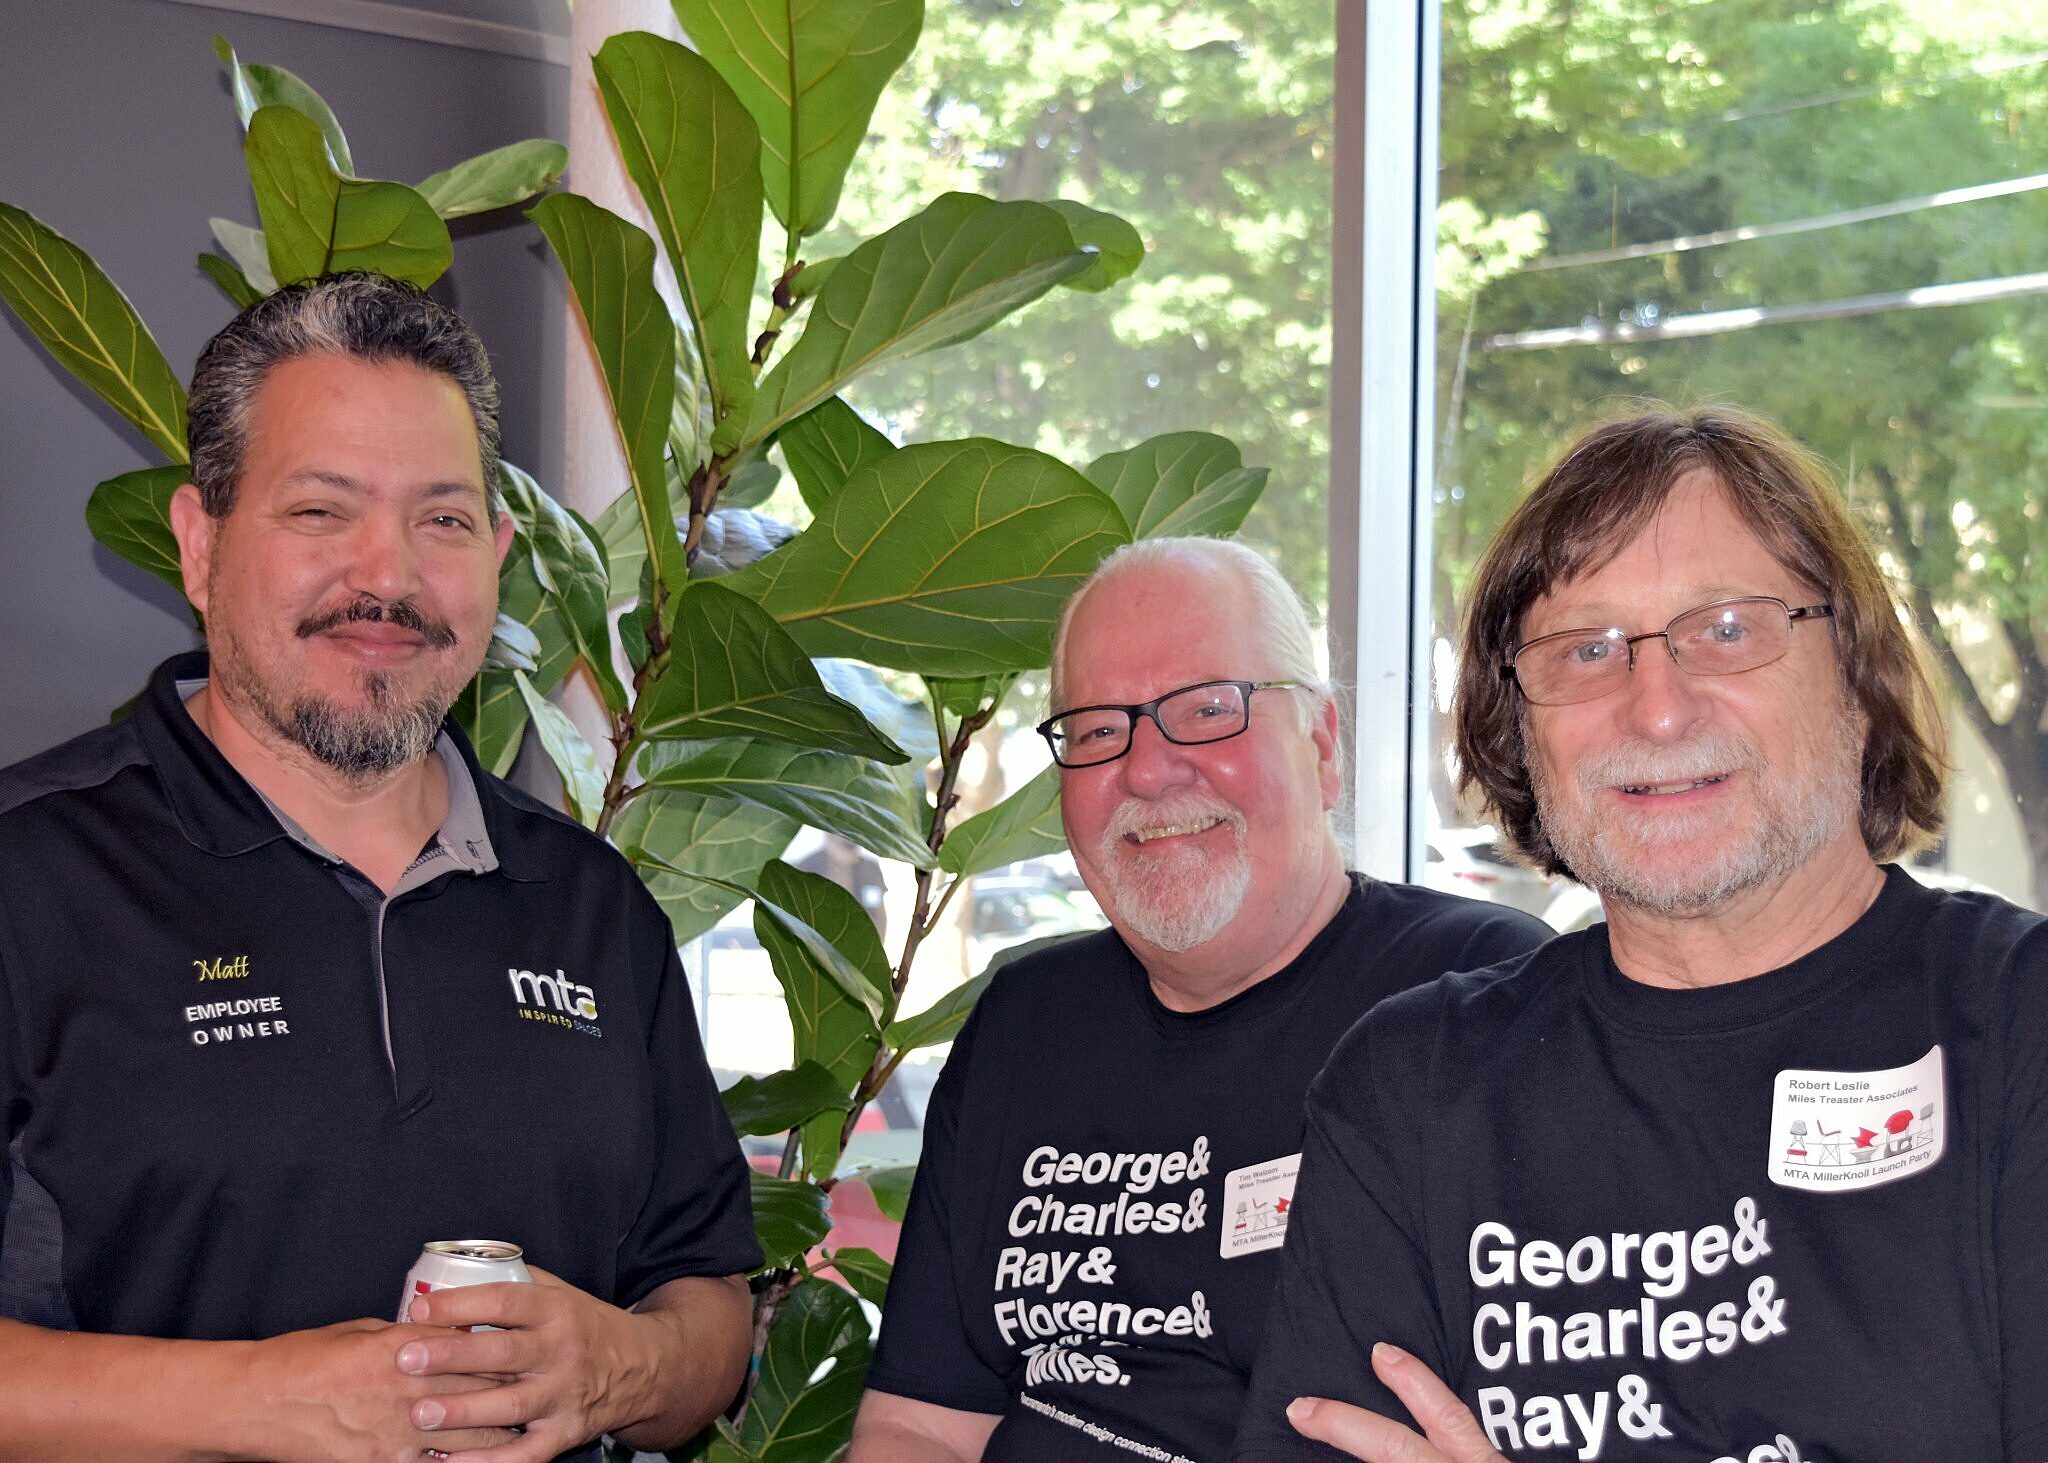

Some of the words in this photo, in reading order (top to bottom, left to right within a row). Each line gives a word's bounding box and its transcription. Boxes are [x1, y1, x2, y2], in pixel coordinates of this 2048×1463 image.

[193, 956, 250, 982] Matt
[186, 997, 282, 1022] EMPLOYEE
[508, 968, 598, 1020] mta
[193, 1020, 290, 1045] OWNER
[519, 1008, 573, 1030] INSPIRED
[1788, 1094, 1816, 1104] Miles
[1820, 1095, 1864, 1105] Treaster
[1866, 1084, 1918, 1103] Associates
[1789, 1079, 1830, 1091] Robert
[1834, 1081, 1870, 1091] Leslie
[1022, 1136, 1211, 1194] George&
[1784, 1168, 1810, 1180] MTA
[1813, 1167, 1870, 1182] MillerKnoll
[1872, 1160, 1907, 1176] Launch
[1908, 1149, 1932, 1166] Party
[1007, 1188, 1208, 1238] Charles&
[1232, 1239, 1249, 1248] MTA
[1469, 1197, 1772, 1298] George&
[994, 1246, 1117, 1294] Ray&
[994, 1291, 1213, 1346] Florence&
[1473, 1275, 1787, 1370] Charles&
[1478, 1374, 1673, 1463] Ray&
[1082, 1422, 1116, 1442] design
[1113, 1435, 1172, 1462] connection
